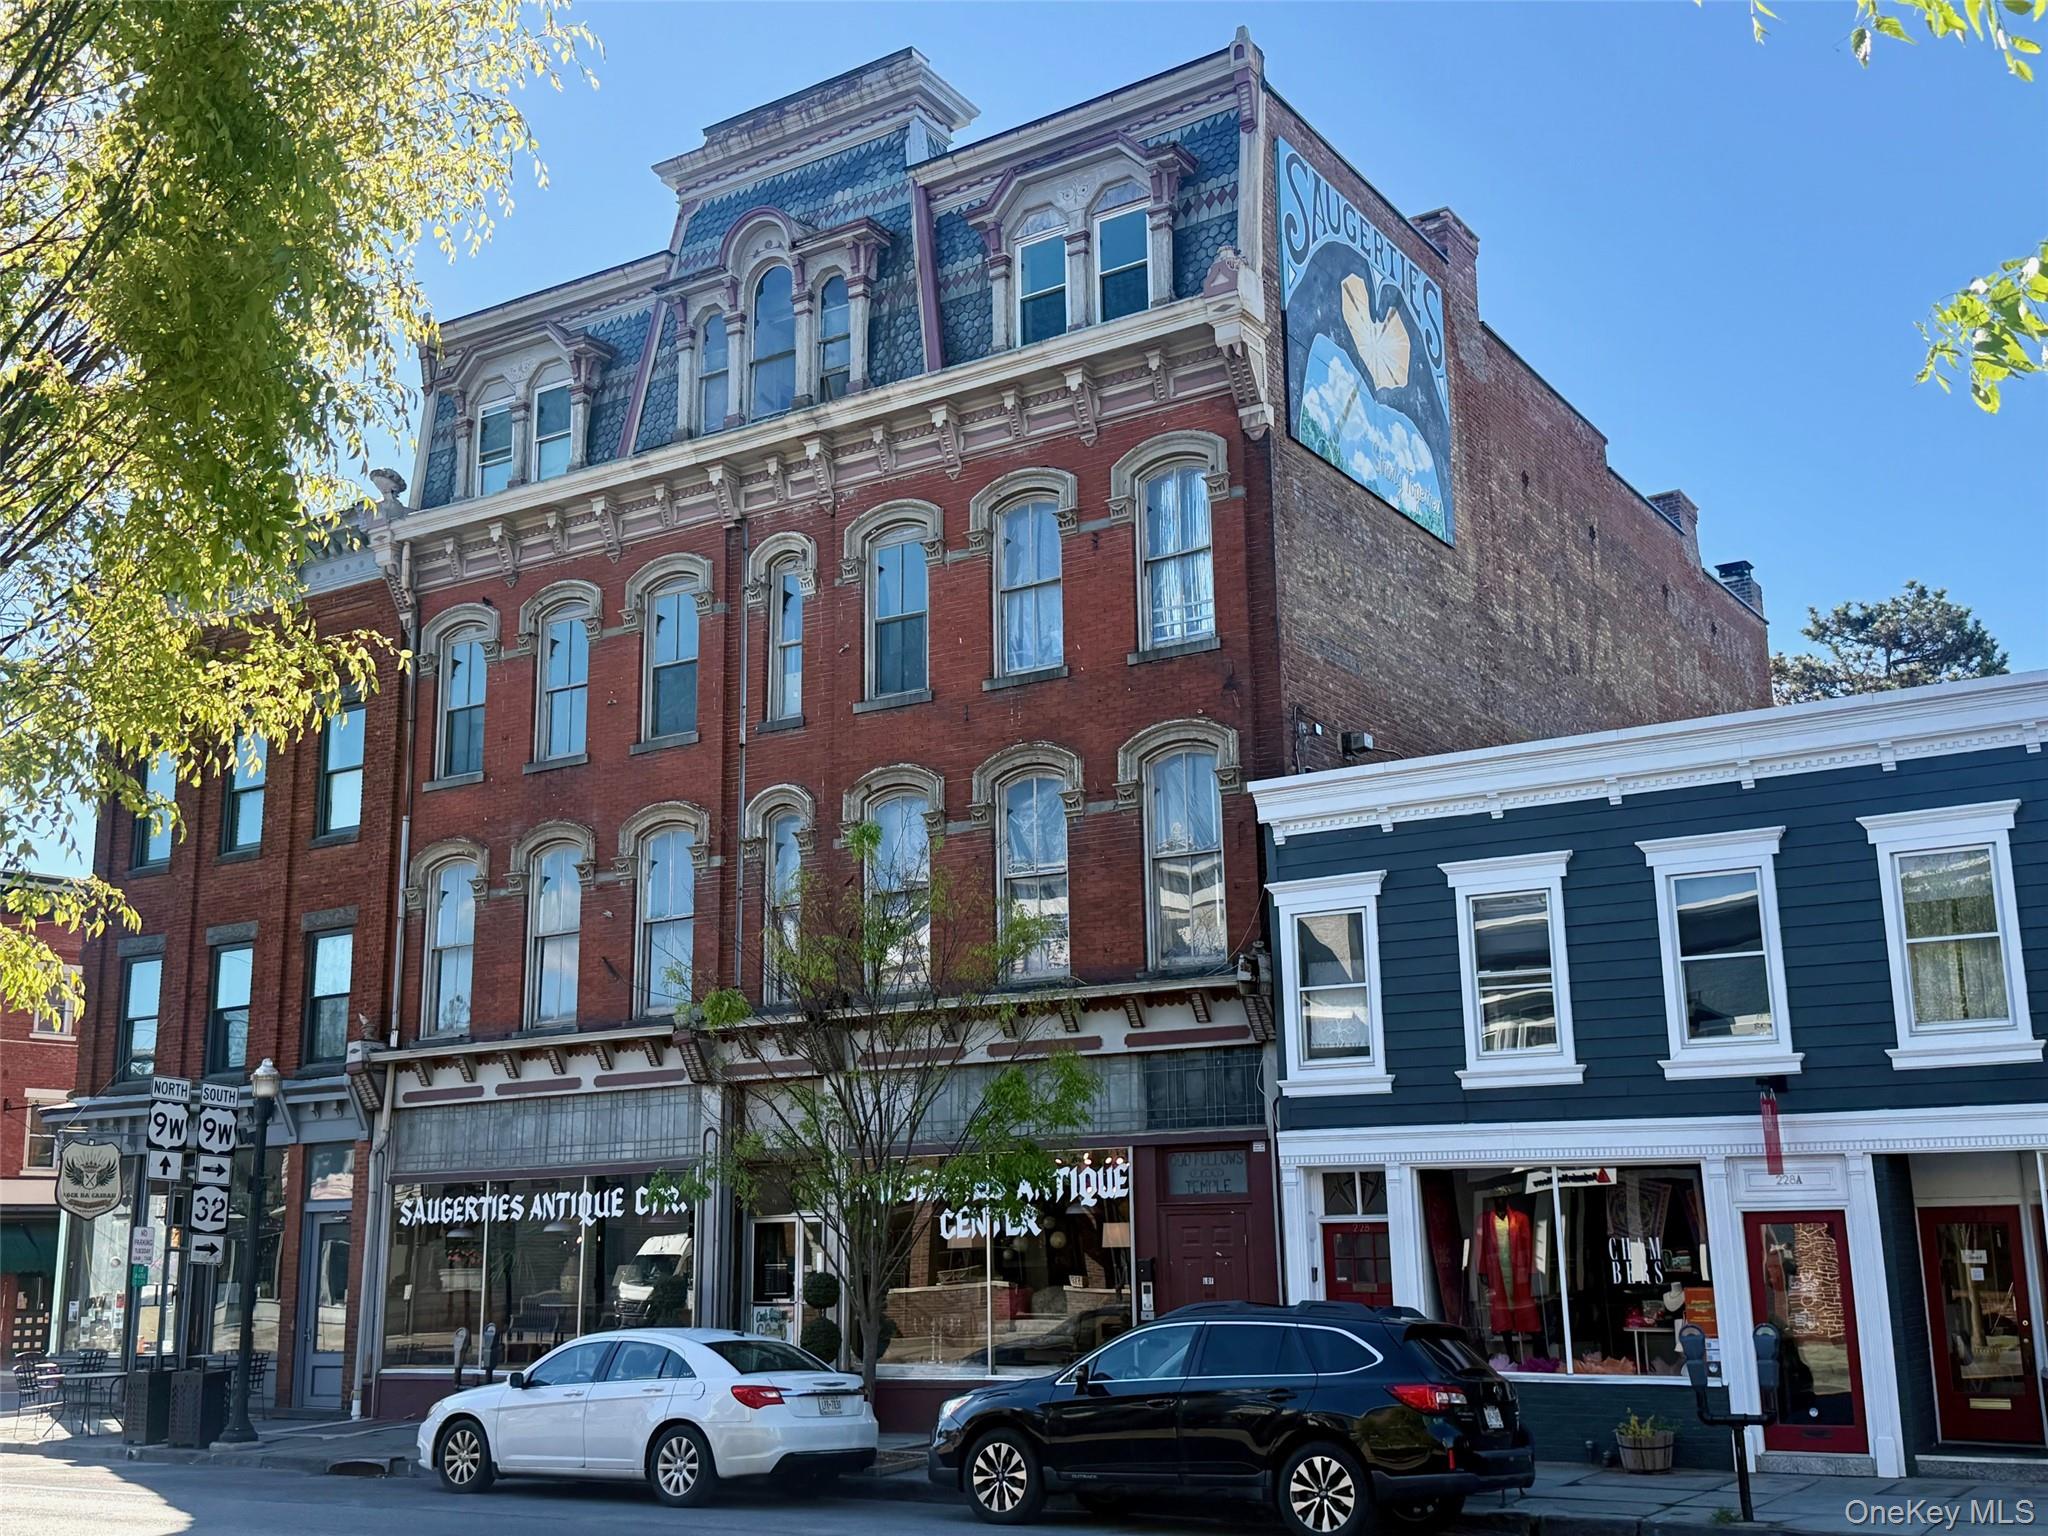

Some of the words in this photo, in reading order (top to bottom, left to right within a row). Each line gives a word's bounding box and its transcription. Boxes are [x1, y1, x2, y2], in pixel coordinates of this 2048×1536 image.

[1285, 153, 1443, 364] SAUGERTIES
[153, 1080, 188, 1098] NORTH
[202, 1087, 236, 1104] SOUTH
[153, 1112, 185, 1140] 9W
[202, 1117, 233, 1145] 9W
[1185, 1178, 1233, 1193] TEMPLE
[1775, 1174, 1803, 1185] 228A
[194, 1196, 226, 1223] 32
[399, 1193, 525, 1227] SAUGERTIES
[528, 1186, 626, 1227] ANTIQUE
